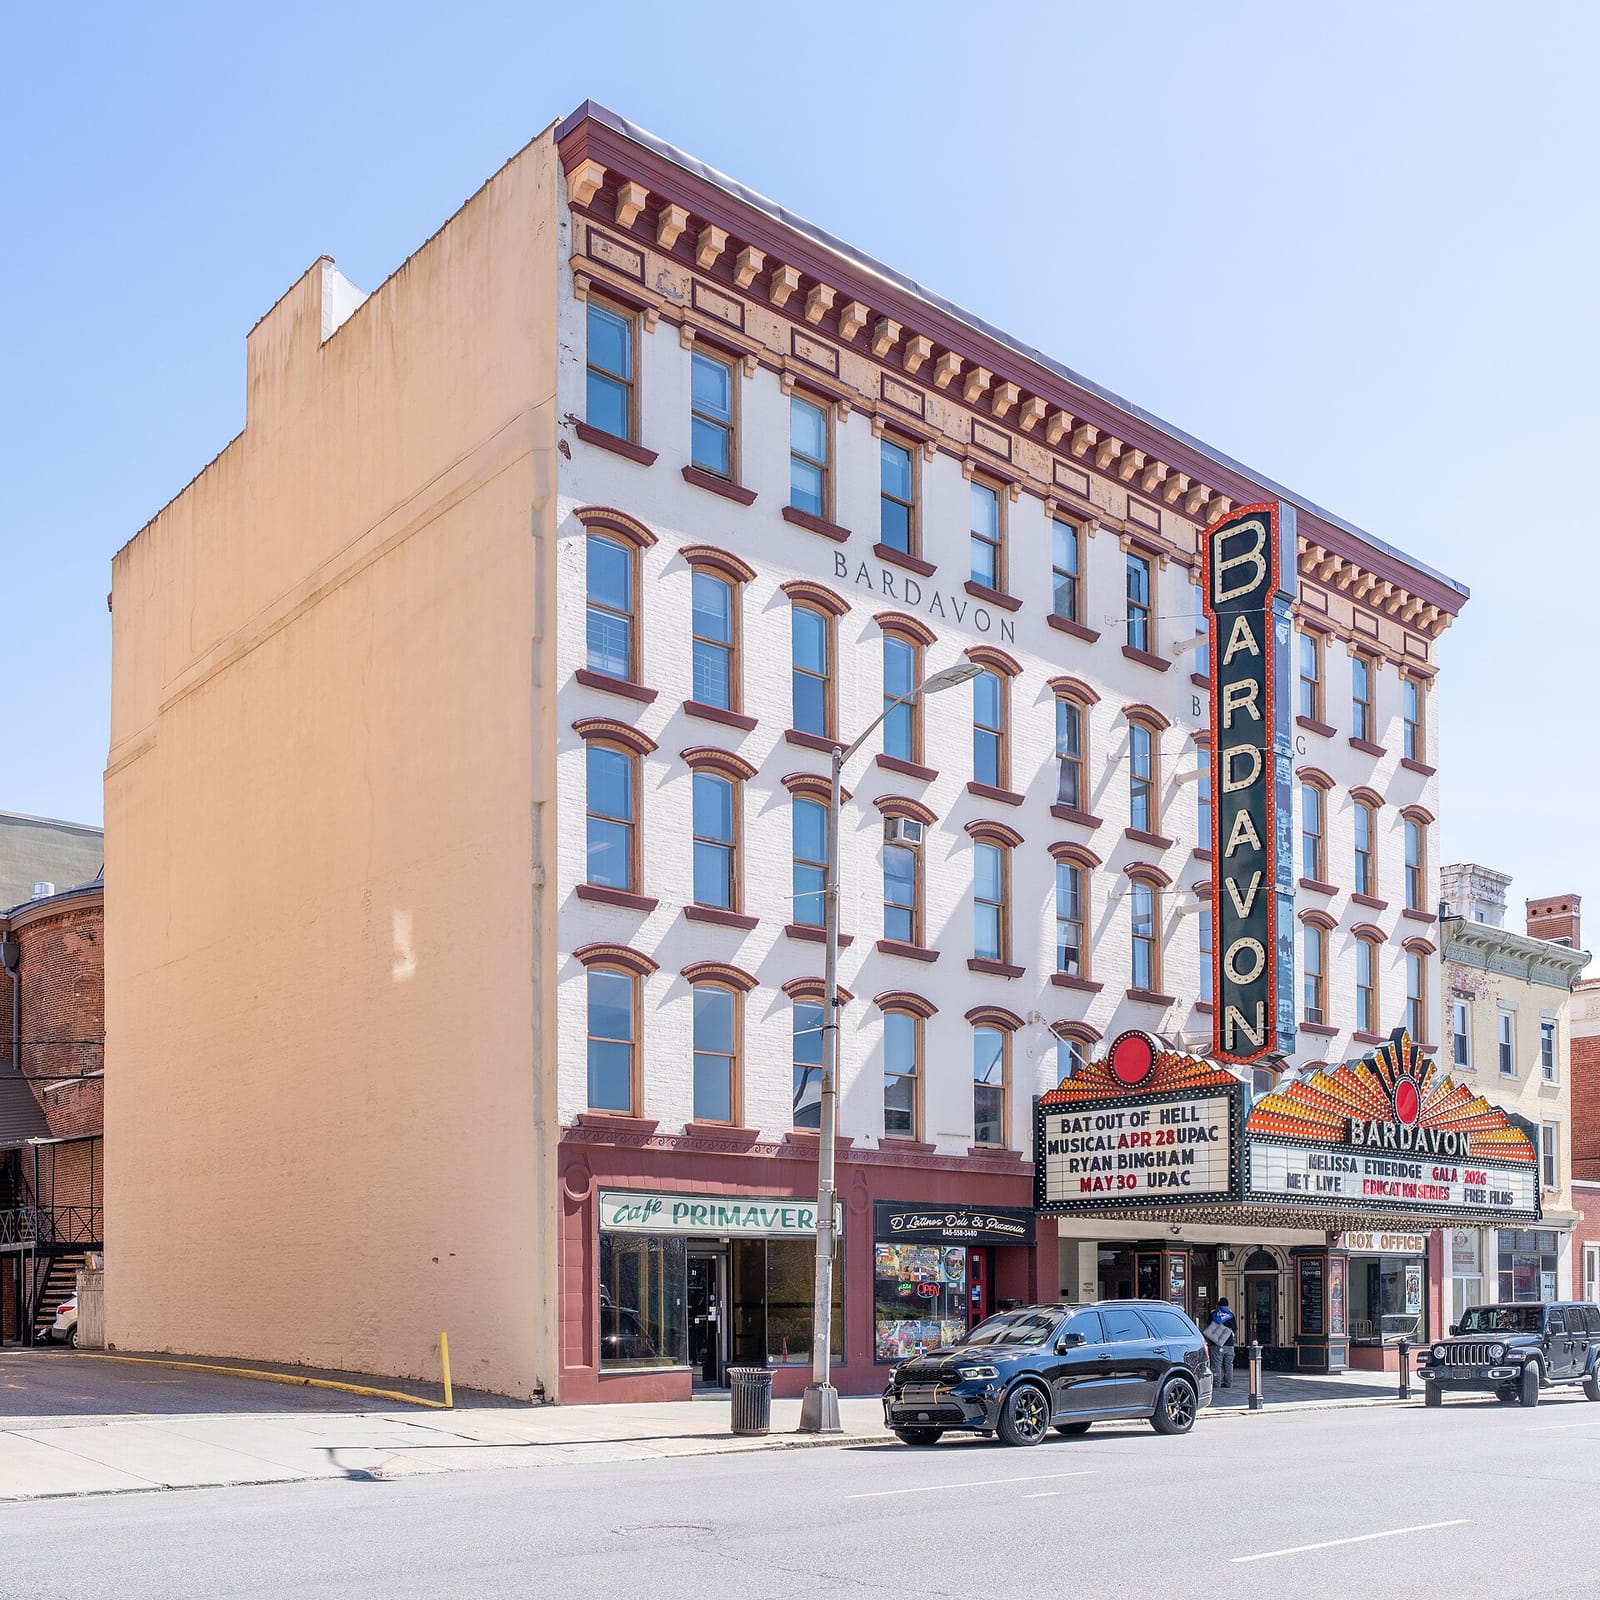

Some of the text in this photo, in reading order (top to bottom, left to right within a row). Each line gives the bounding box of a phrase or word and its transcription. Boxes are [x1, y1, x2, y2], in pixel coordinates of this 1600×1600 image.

[833, 550, 1015, 644] BARDAVON
[1214, 519, 1267, 1050] BARDAVON
[1061, 1105, 1200, 1134] BAT OUT OF HELL
[1047, 1125, 1219, 1155] MUSICAL APR 28 UPAC
[1351, 1117, 1471, 1156] BARDAVON
[1069, 1149, 1194, 1173] RYAN BINGHAM
[1308, 1153, 1487, 1185] MELISSA ETHERIDGE GALA 2026
[1080, 1170, 1191, 1192] MAY 30 UPAC
[1287, 1172, 1310, 1190] MET
[1316, 1175, 1341, 1192] LIVE
[1417, 1183, 1450, 1201] SERIES
[1464, 1187, 1486, 1204] FREE
[1489, 1190, 1514, 1205] FILMS
[672, 1202, 818, 1229] PRIMAVER
[945, 1214, 968, 1227] Deli
[972, 1216, 983, 1228] &
[1348, 1232, 1422, 1250] BOX OFFICE
[917, 1283, 940, 1297] OPEN
